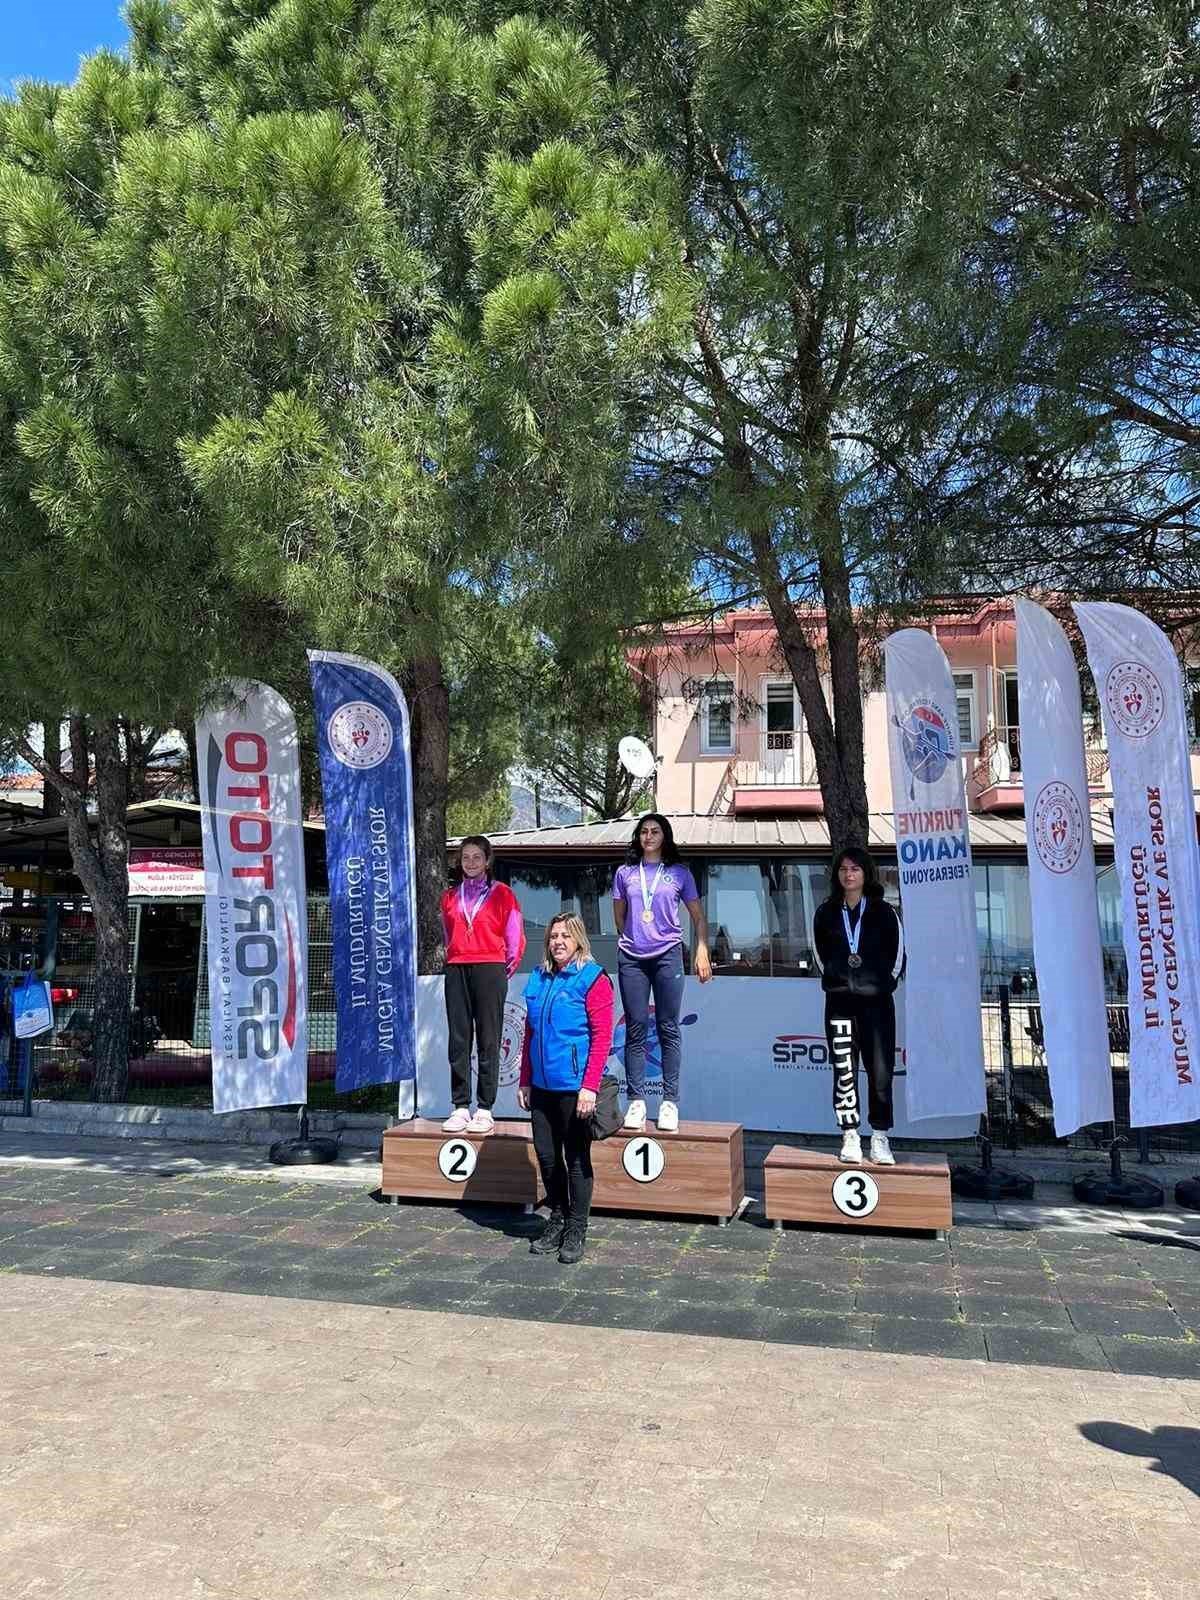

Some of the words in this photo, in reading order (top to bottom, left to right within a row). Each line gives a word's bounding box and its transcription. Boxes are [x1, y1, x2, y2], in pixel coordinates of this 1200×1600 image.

[772, 1043, 828, 1064] SPO
[830, 1019, 860, 1126] FUTURE
[449, 1144, 467, 1175] 2
[635, 1143, 649, 1176] 1
[845, 1176, 868, 1211] 3
